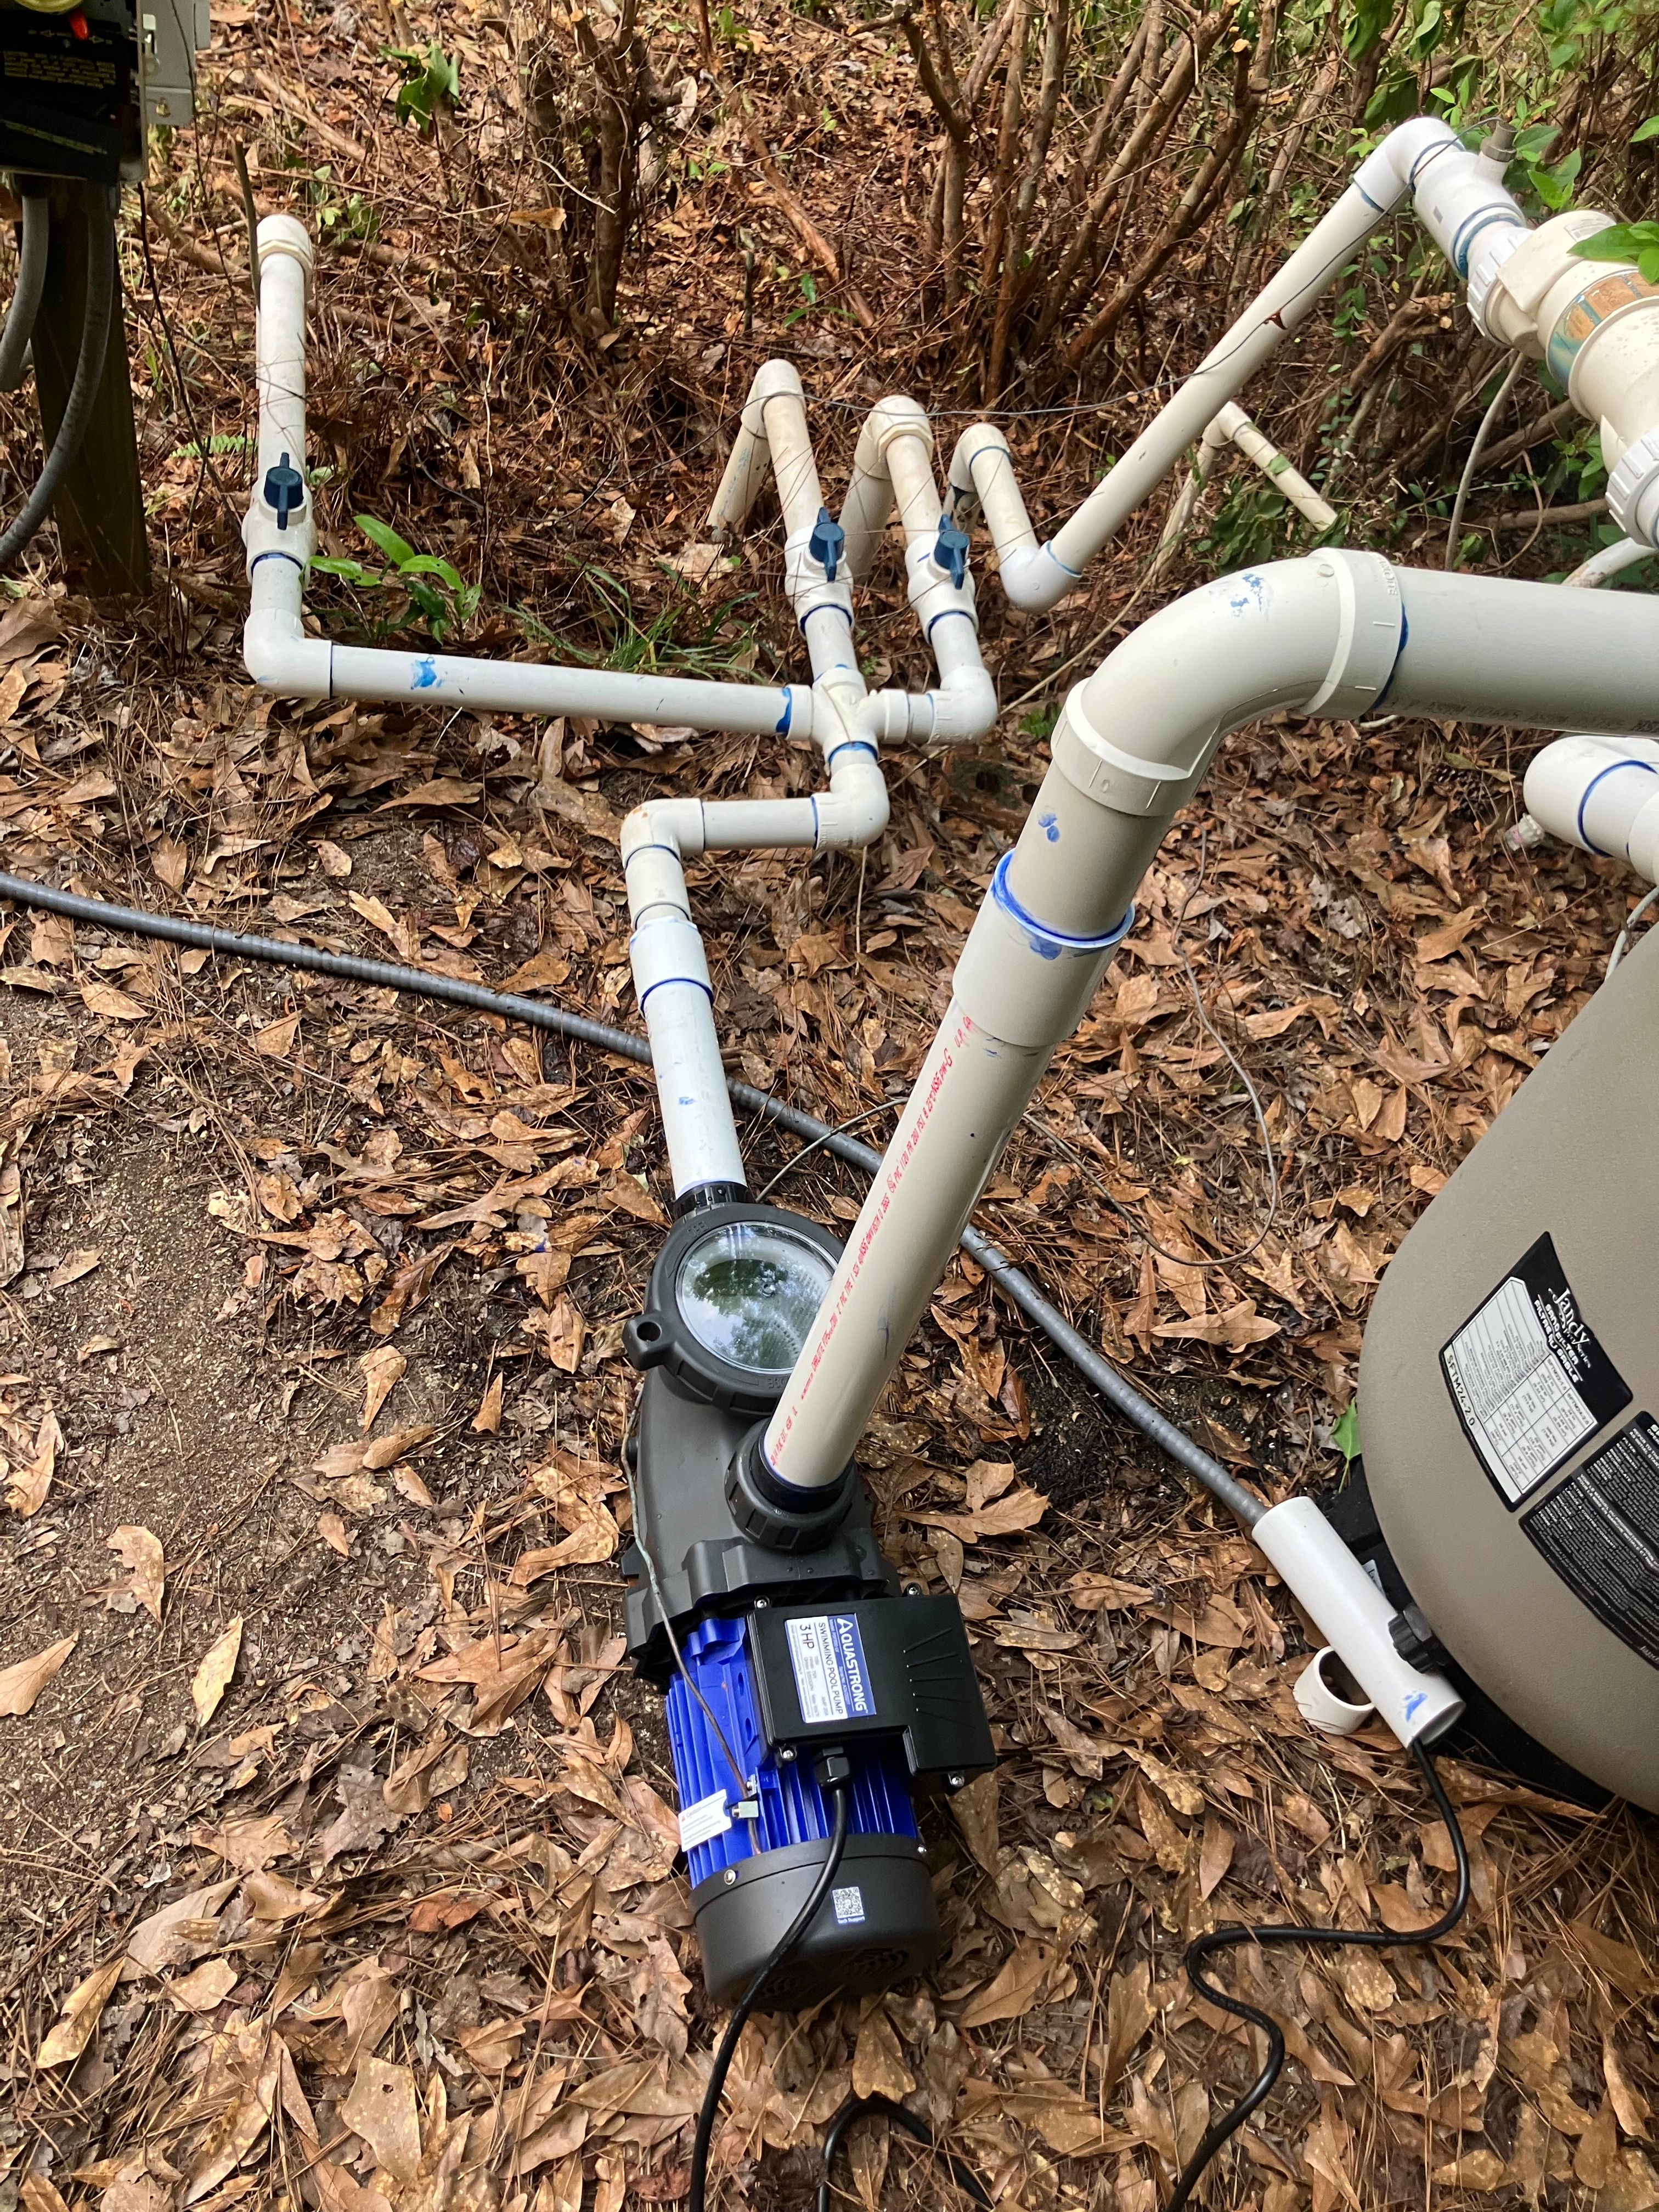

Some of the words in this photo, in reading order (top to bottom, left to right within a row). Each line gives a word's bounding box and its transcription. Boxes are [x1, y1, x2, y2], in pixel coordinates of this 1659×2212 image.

[1547, 1286, 1590, 1345] Jandy
[1446, 1354, 1476, 1426] SFTM24-2.0
[818, 1621, 833, 1666] SWIMMING
[836, 1617, 867, 1712] AQUASTRONG
[827, 1666, 838, 1689] POOL
[831, 1689, 843, 1713] PUMP
